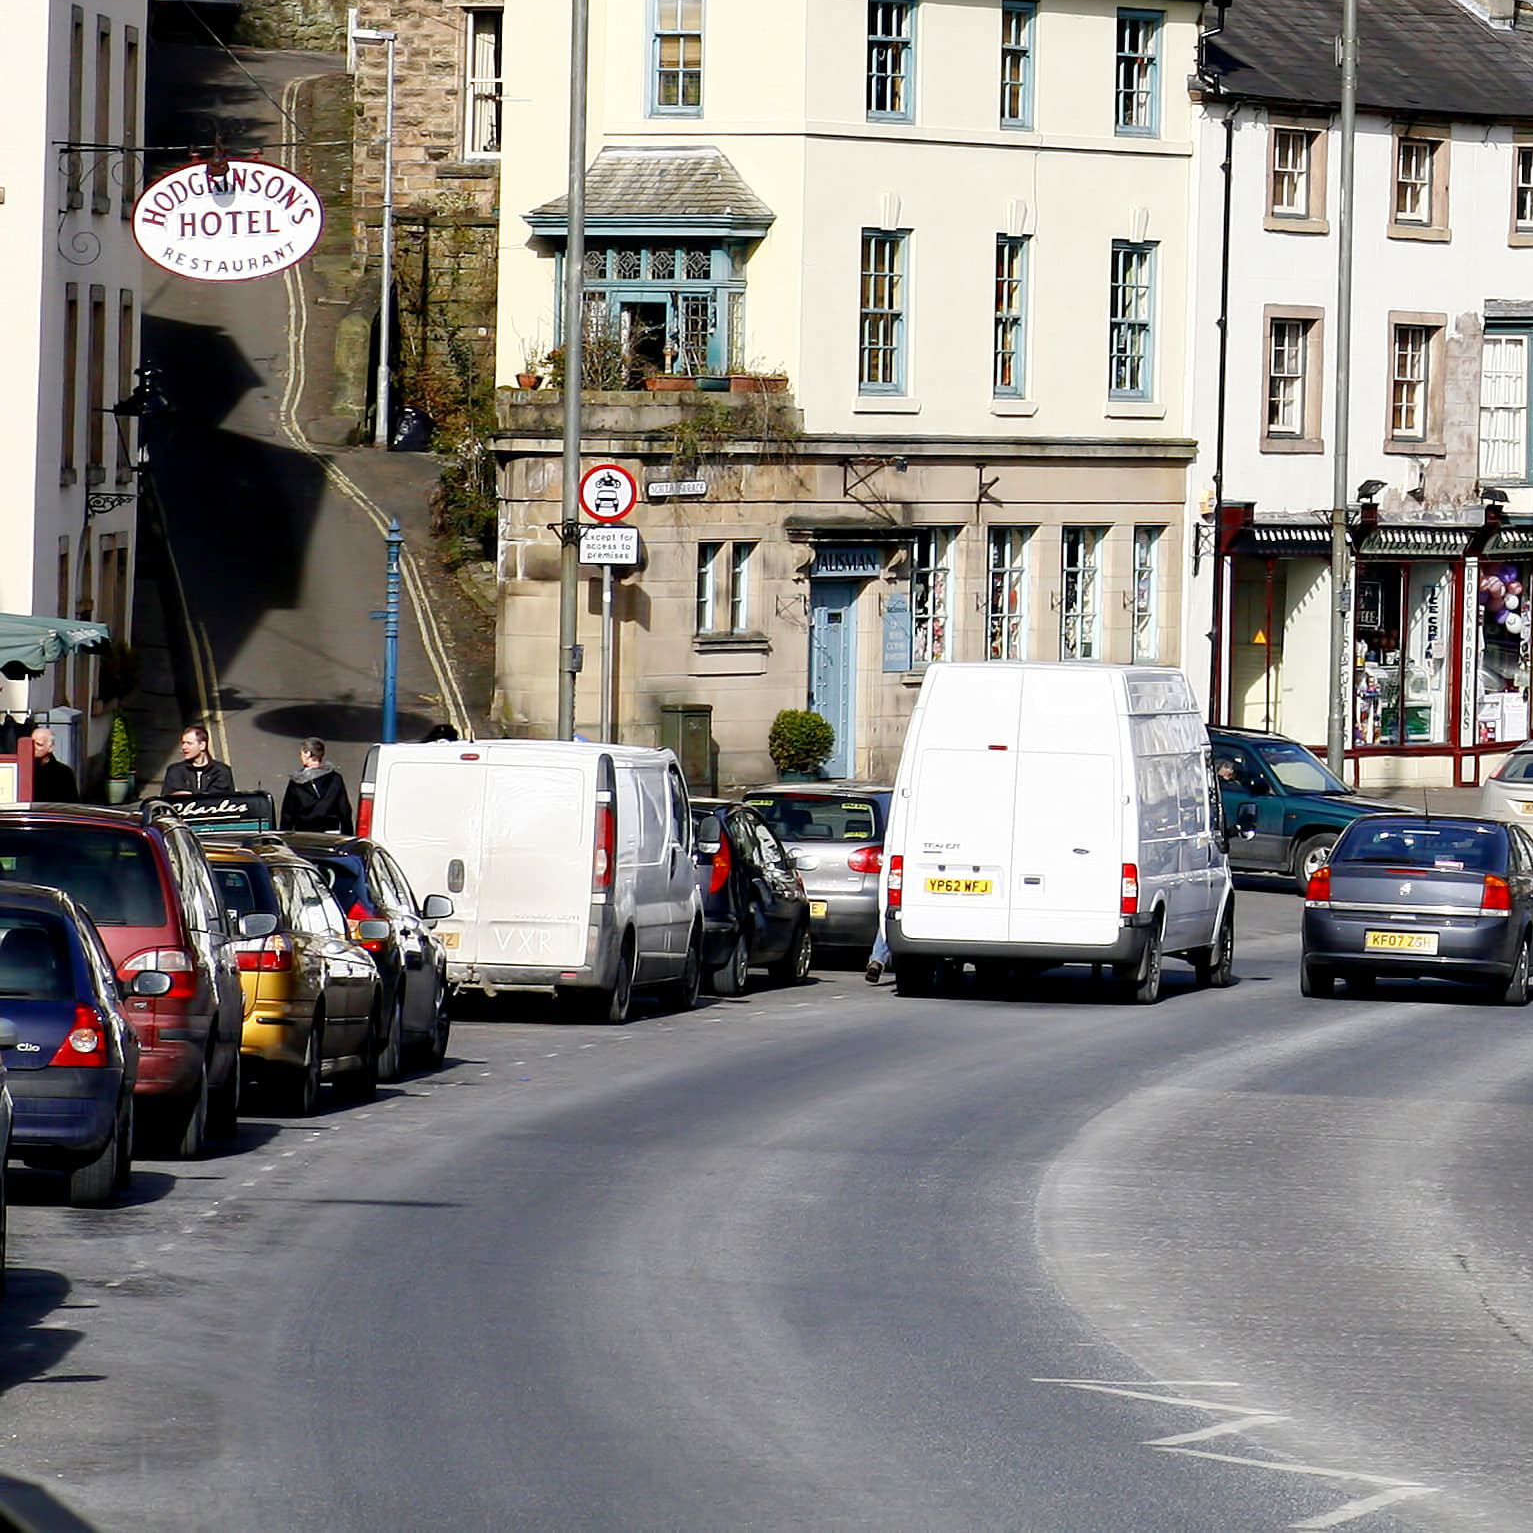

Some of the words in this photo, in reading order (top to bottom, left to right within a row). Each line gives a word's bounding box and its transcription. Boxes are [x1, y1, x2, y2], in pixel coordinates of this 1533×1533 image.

[178, 210, 280, 237] HOTEL
[162, 241, 295, 273] RESTAURANT
[584, 533, 616, 544] Except
[620, 532, 633, 542] for
[621, 542, 631, 550] to
[587, 551, 630, 560] premises
[815, 553, 877, 572] TALISMAN
[1429, 587, 1438, 615] ICE
[1465, 567, 1475, 625] ROCK
[1463, 647, 1474, 732] DRINKS
[172, 799, 248, 816] Charles
[929, 880, 961, 893] YP62
[494, 926, 553, 955] VXR
[1372, 933, 1404, 946] KF07
[16, 1042, 41, 1052] Clio
